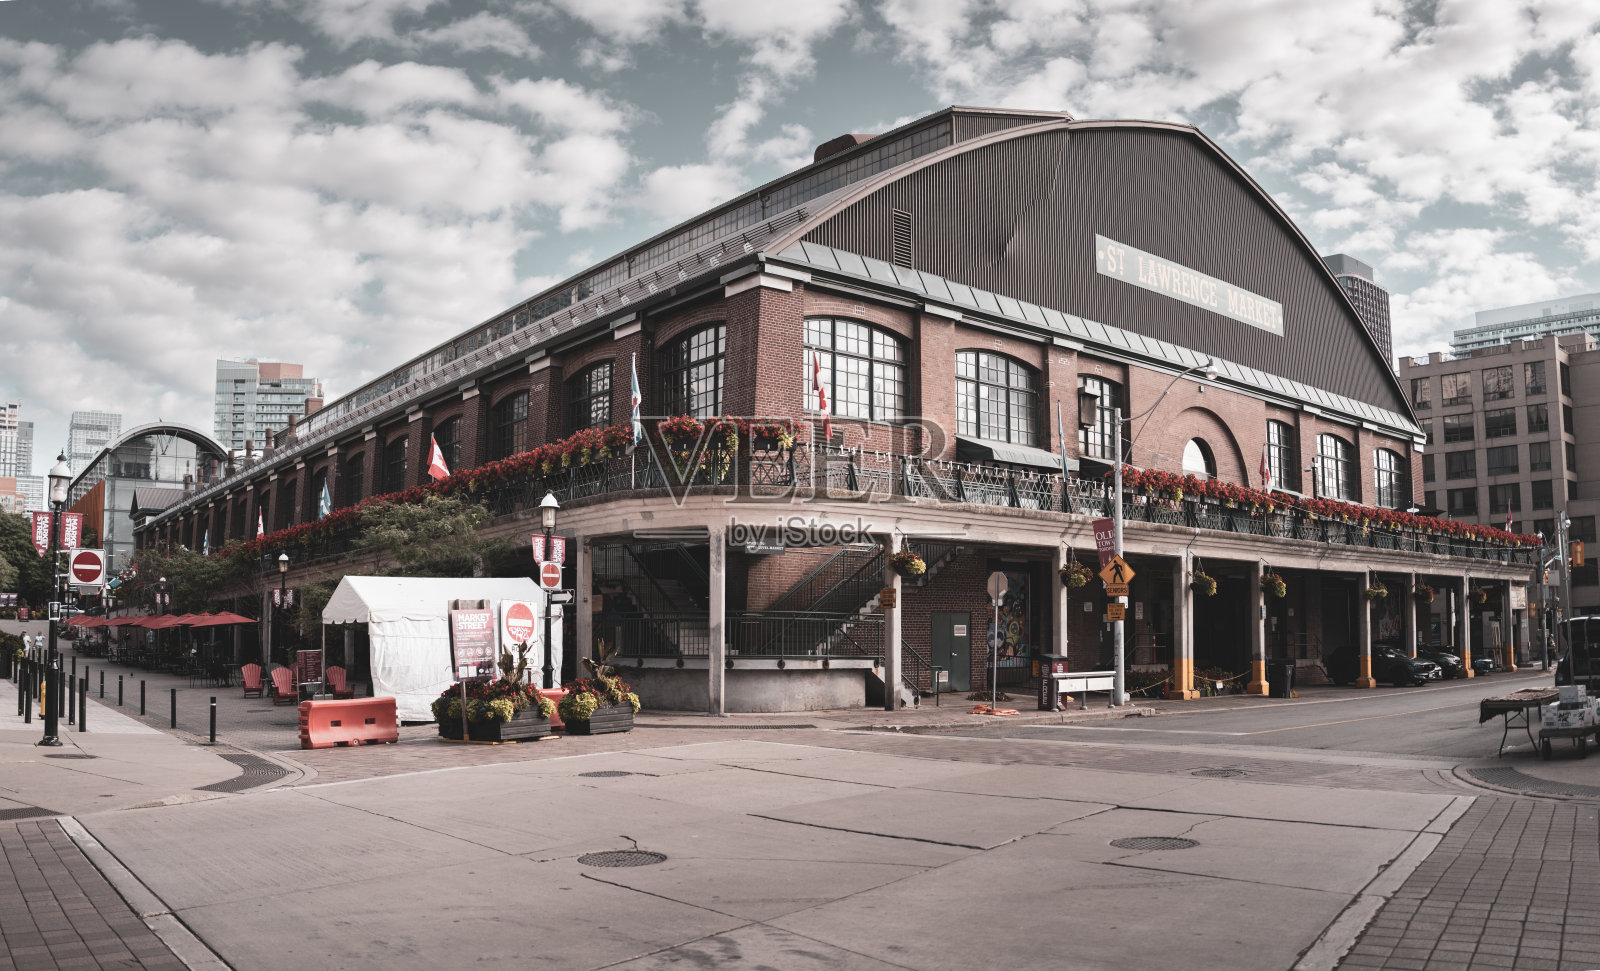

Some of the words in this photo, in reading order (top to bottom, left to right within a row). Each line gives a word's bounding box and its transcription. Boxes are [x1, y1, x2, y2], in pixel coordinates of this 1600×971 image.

[1138, 254, 1218, 308] LAWRENCE
[1227, 288, 1277, 329] MARKET
[1095, 530, 1114, 541] OLD
[457, 612, 490, 623] MARKET
[458, 621, 487, 630] STREET
